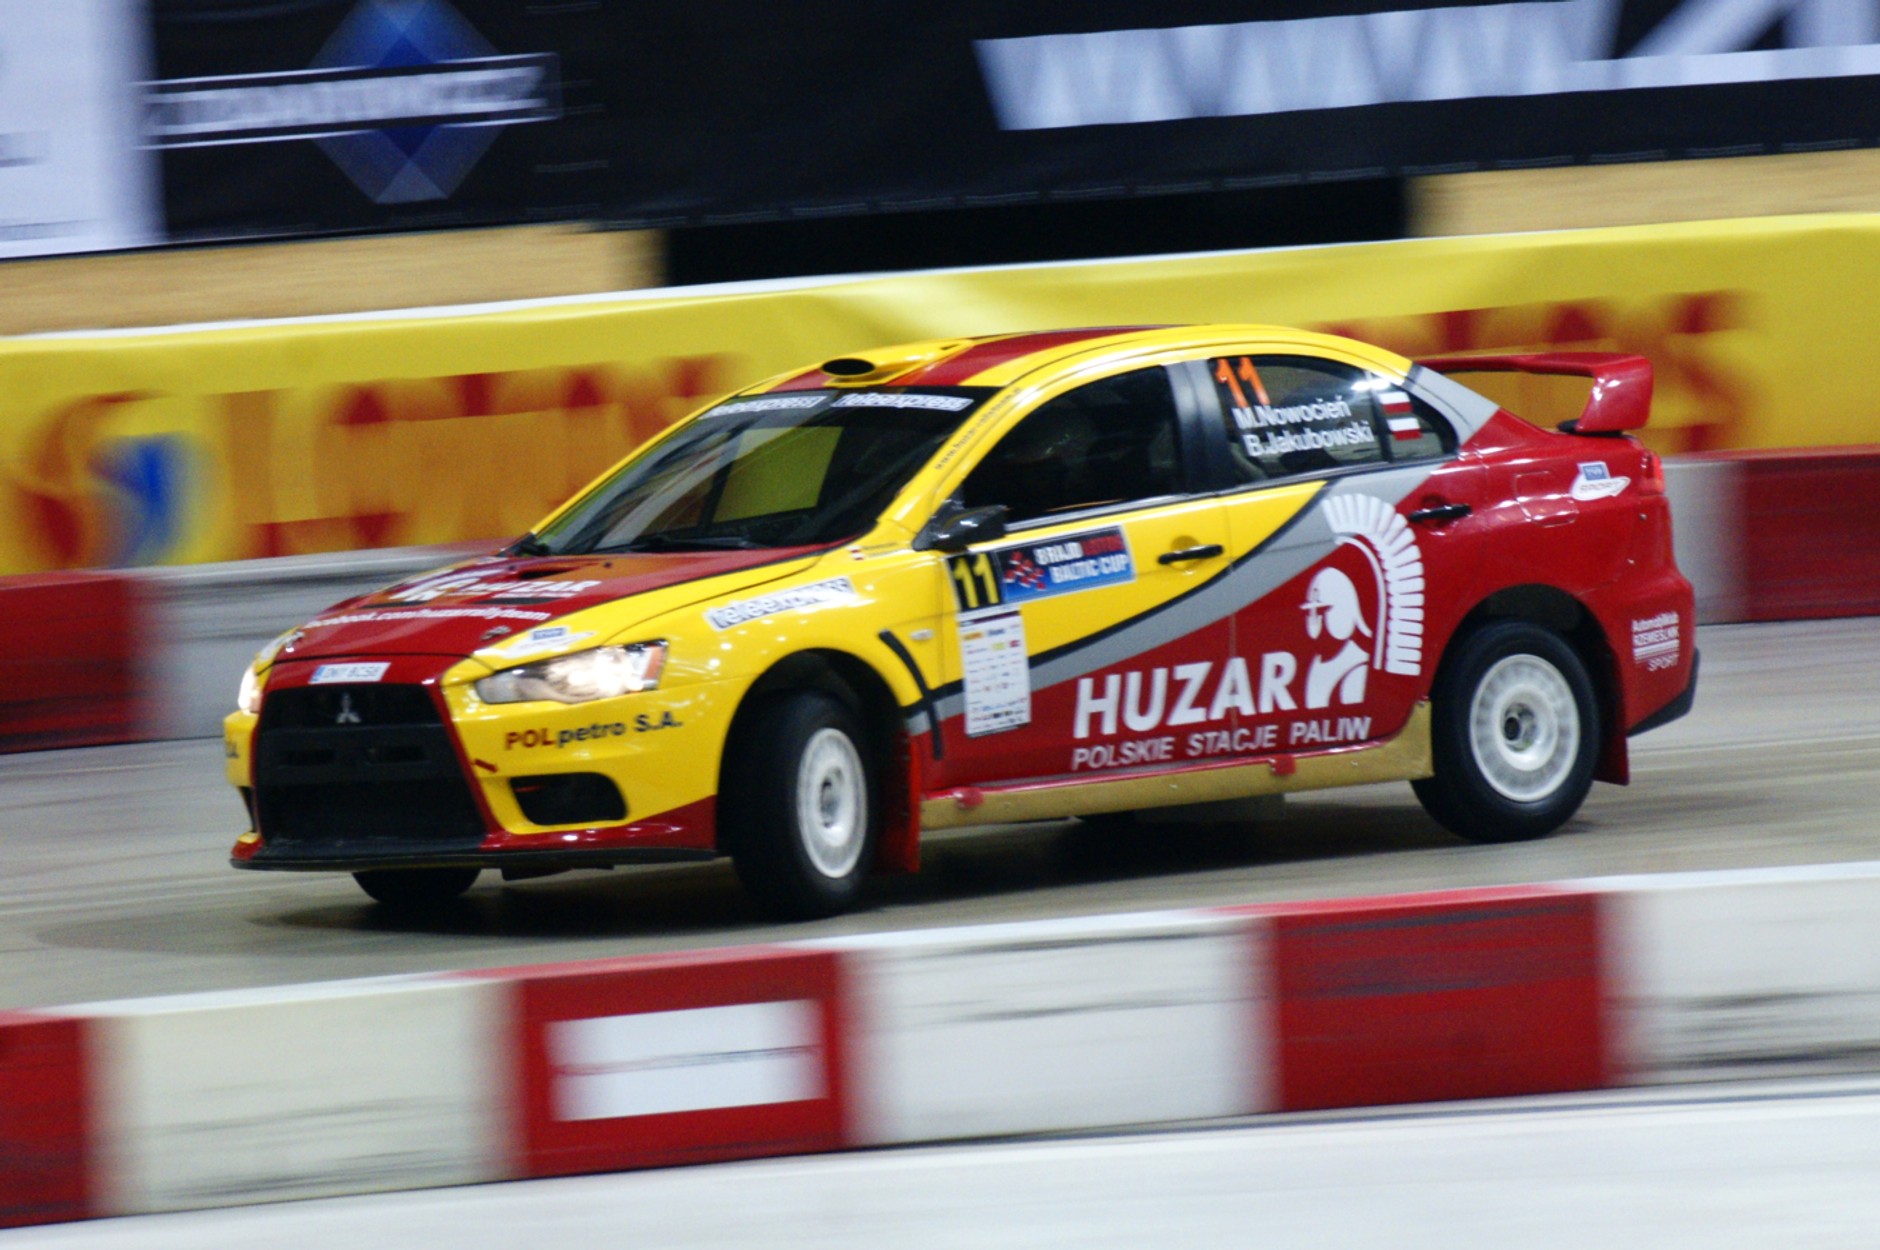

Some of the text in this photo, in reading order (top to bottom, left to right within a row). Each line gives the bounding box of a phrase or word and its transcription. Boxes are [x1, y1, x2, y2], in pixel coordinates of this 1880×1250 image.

[1215, 357, 1270, 408] 11
[1242, 420, 1375, 457] B.Jakubowski
[954, 552, 999, 608] 11
[1051, 554, 1130, 583] BALTIC CUP
[1073, 652, 1298, 739] HUZAR
[505, 711, 683, 750] POLpetro S.A.
[1072, 716, 1372, 771] POLSKIE STACJE PALIW
